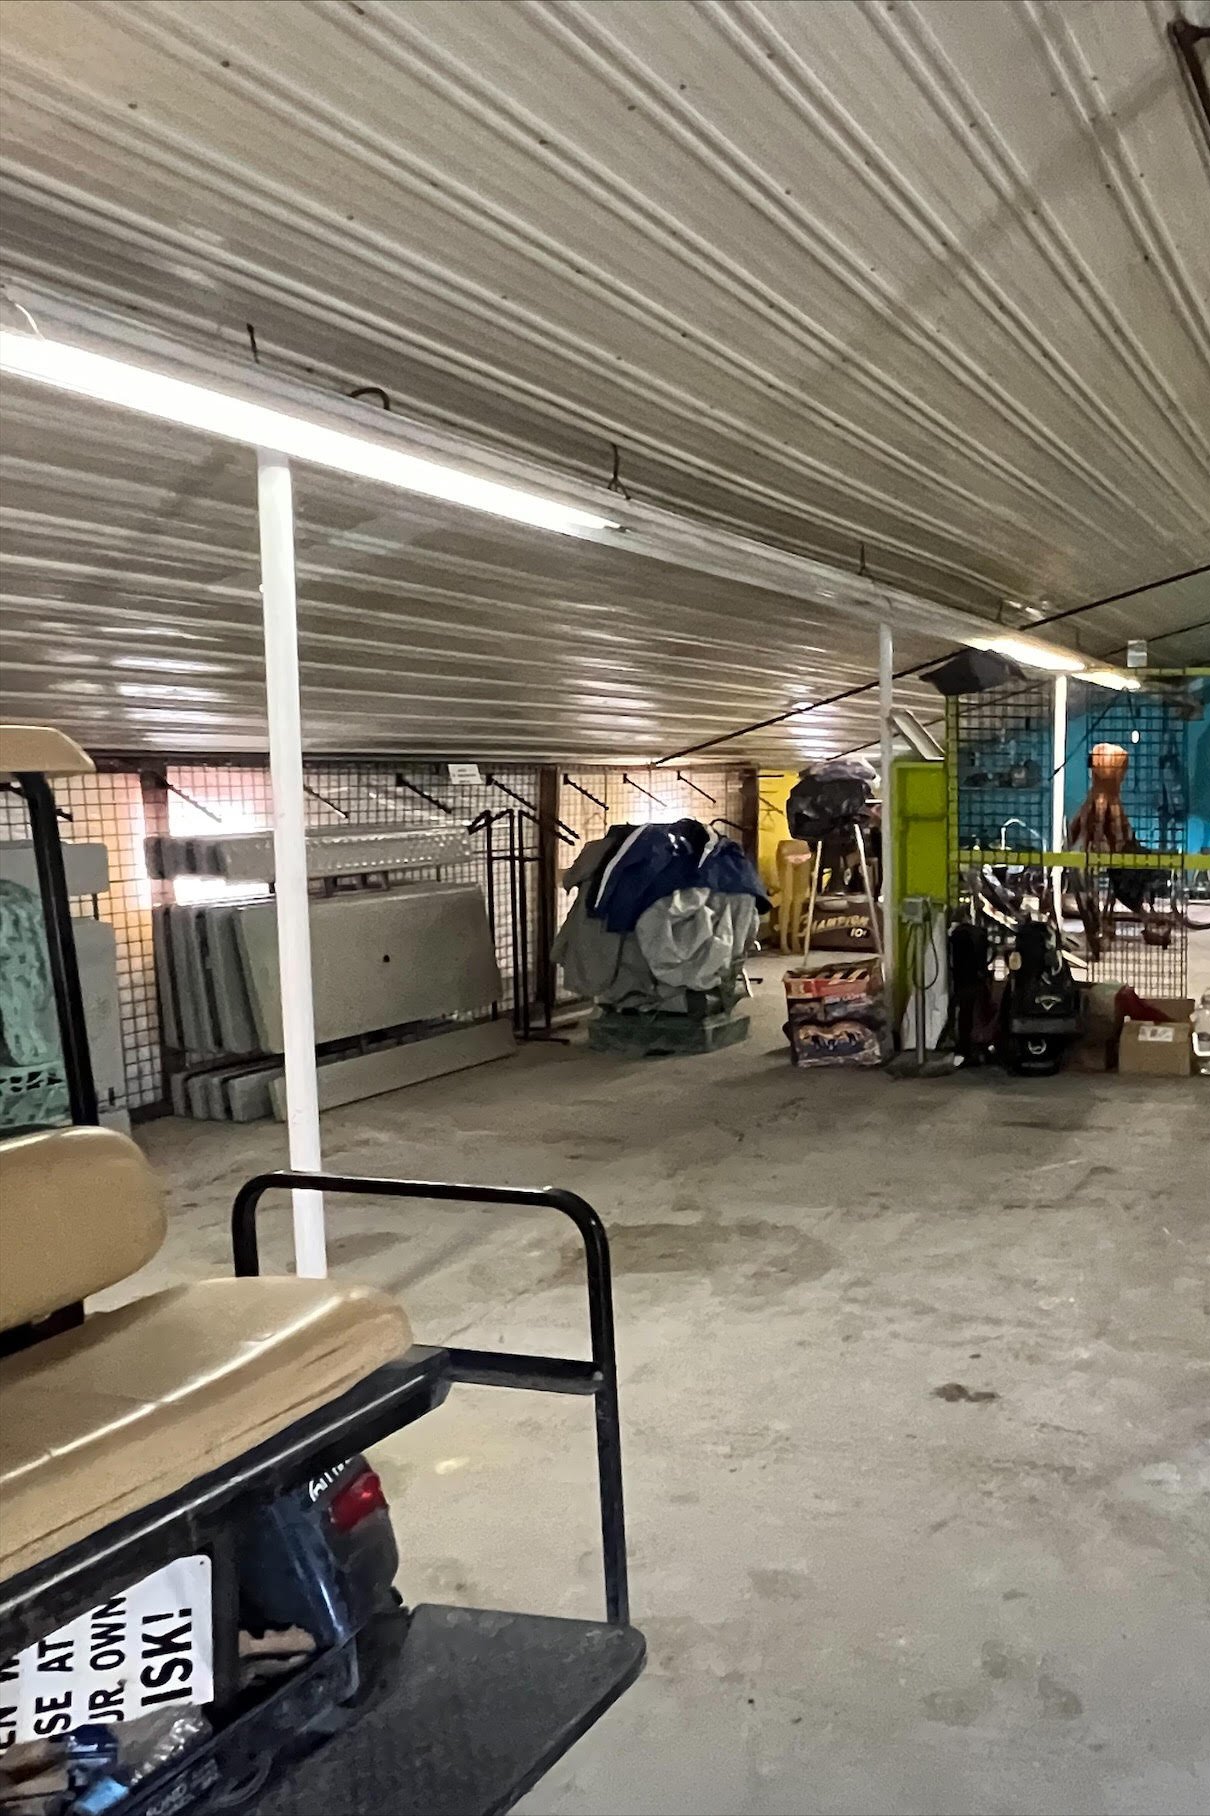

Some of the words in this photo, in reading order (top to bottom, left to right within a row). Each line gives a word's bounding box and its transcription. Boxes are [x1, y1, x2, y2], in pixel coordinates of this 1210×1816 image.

[37, 1638, 74, 1672] AT
[90, 1597, 126, 1671] OWN
[140, 1608, 193, 1707] ISK!
[34, 1691, 73, 1735] SE
